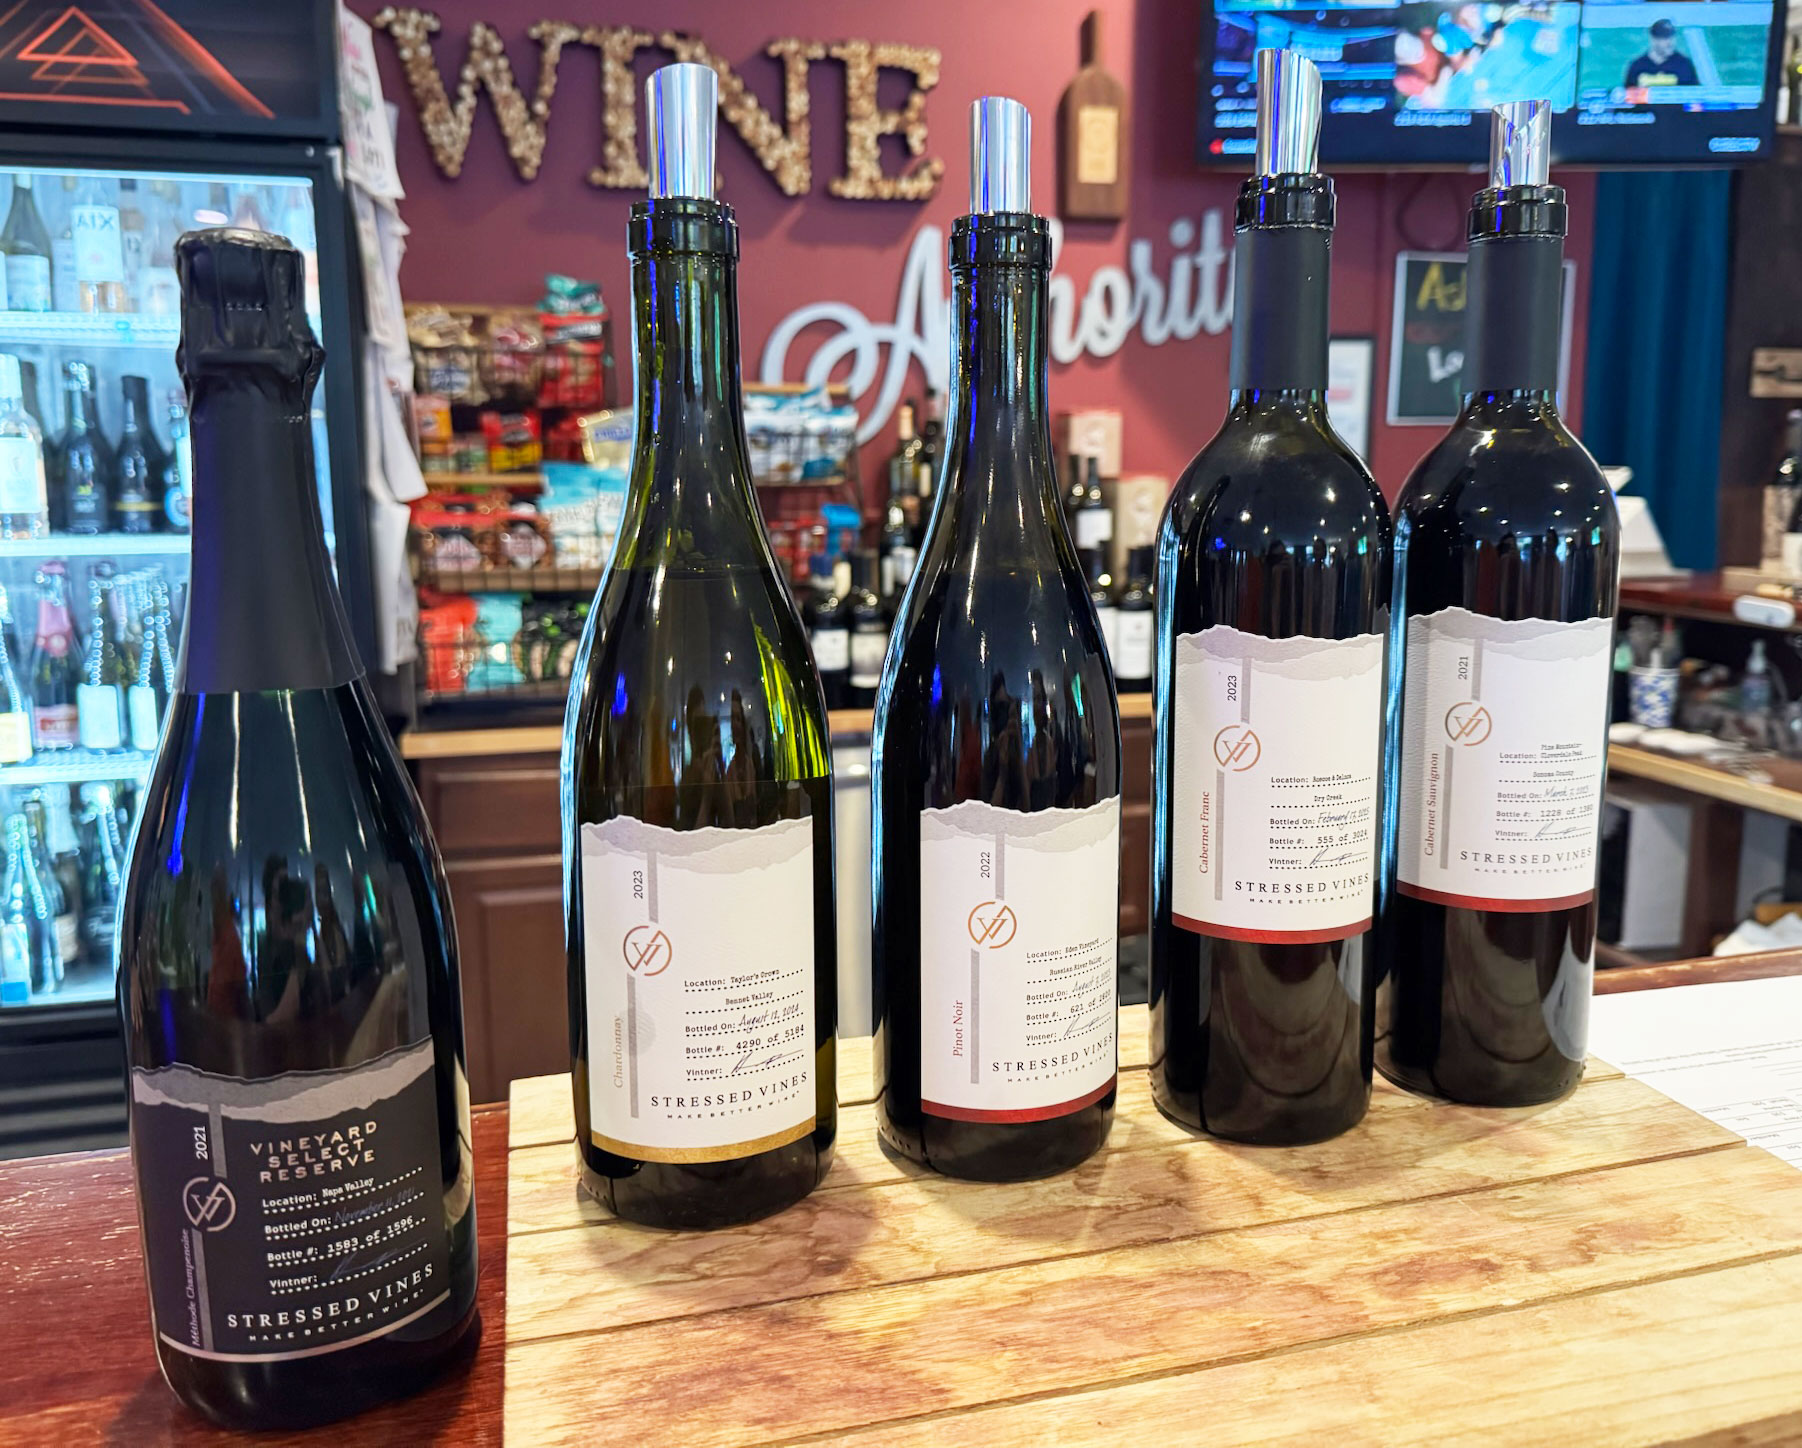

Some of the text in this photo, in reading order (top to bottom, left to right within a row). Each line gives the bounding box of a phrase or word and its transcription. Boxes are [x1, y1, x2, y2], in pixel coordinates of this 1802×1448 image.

[372, 6, 945, 199] WINE
[1458, 656, 1469, 680] 2021
[1228, 675, 1237, 702] 2023
[1424, 752, 1440, 856] Cabernet Sauvignon
[1540, 809, 1562, 817] 1228
[1199, 791, 1210, 874] Cabernet Franc
[1317, 836, 1334, 844] 555
[1339, 834, 1348, 842] of
[980, 851, 991, 878] 2022
[1460, 847, 1592, 864] STRESSED VINES
[633, 870, 644, 899] 2023
[1235, 873, 1369, 893] STRESSED VINES
[1026, 949, 1062, 959] Location:
[684, 979, 725, 987] Location:
[731, 974, 759, 984] Taylor's
[1050, 966, 1073, 976] Russian
[1074, 961, 1088, 971] River
[725, 991, 773, 1005] Bennet Valley
[1026, 991, 1054, 1001] Bottled
[1026, 1013, 1050, 1021] Bottle
[1070, 1004, 1084, 1014] 621
[1088, 997, 1097, 1007] of
[685, 1024, 718, 1033] Bottled
[721, 1022, 735, 1030] On:
[738, 1010, 769, 1034] August
[953, 1000, 963, 1058] Pinot Noir
[685, 1046, 713, 1054] Bottle
[736, 1038, 761, 1050] 4290
[767, 1034, 779, 1043] of
[784, 1024, 804, 1038] 5184
[1026, 1031, 1057, 1041] Vintner:
[613, 1015, 623, 1089] Chardonnay
[992, 1032, 1113, 1072] STRESSED VINES
[686, 1068, 722, 1076] Vintner:
[1046, 1064, 1086, 1079] BETTER
[651, 1071, 807, 1108] STRESSED VINES
[710, 1104, 762, 1118] BETTER
[193, 1125, 208, 1160] 2021
[250, 1121, 377, 1155] VINEYARD
[260, 1150, 375, 1183] RESERVE
[269, 1139, 365, 1168] SELECT
[262, 1178, 374, 1208] Location: Napa Valley
[264, 1220, 307, 1234] Bottled
[312, 1217, 331, 1227] On:
[267, 1216, 414, 1262] Bottle #: 1583 of 1596
[181, 1229, 196, 1299] Champenoise
[228, 1263, 433, 1328] STRESSED VINES
[269, 1275, 318, 1289] Vintner:
[249, 1331, 294, 1342] MAKE
[305, 1312, 374, 1336] BETTER
